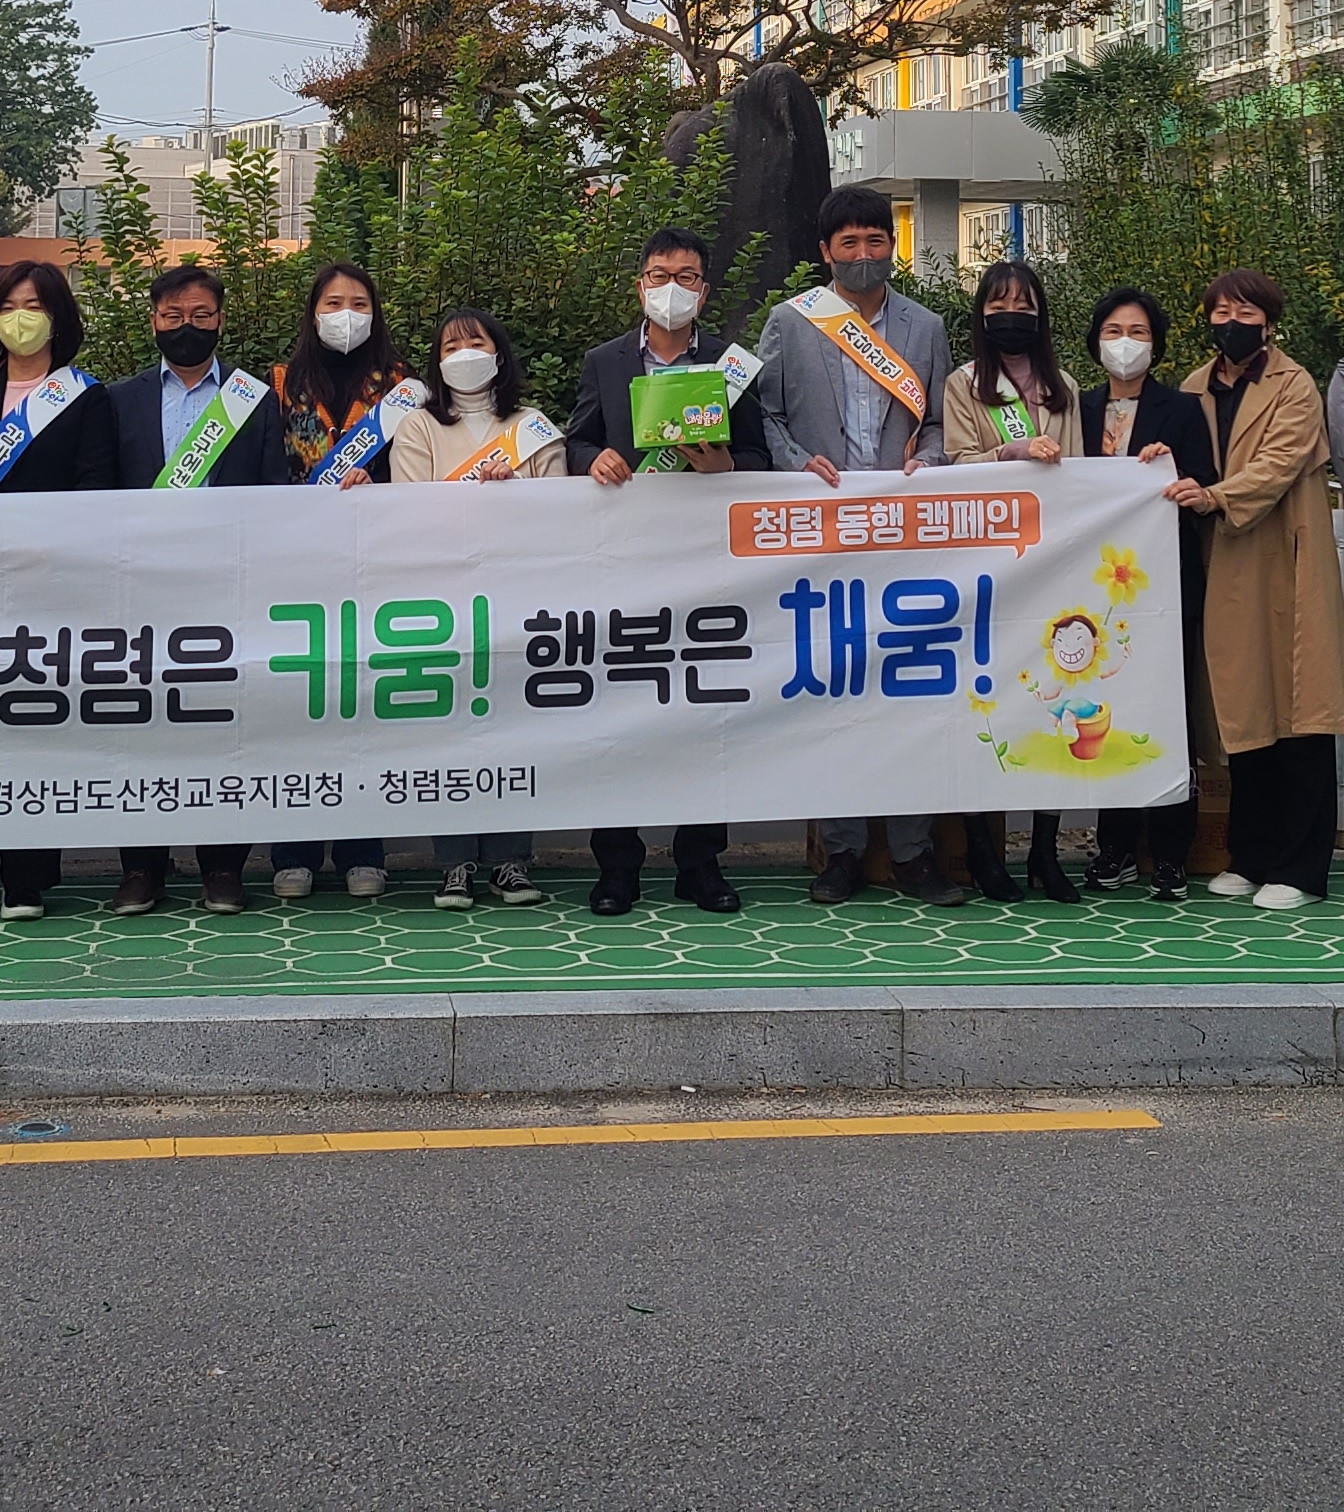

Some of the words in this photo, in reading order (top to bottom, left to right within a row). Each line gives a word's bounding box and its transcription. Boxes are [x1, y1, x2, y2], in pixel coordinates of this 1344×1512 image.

[839, 321, 902, 379] 저당잡힌
[170, 420, 224, 488] 친구에겐
[753, 506, 824, 549] 청렴
[835, 502, 904, 545] 동행
[916, 498, 1021, 543] 캠페인
[268, 594, 490, 721] 키움!
[523, 605, 752, 709] 행복은
[780, 574, 993, 698] 채움!
[378, 765, 537, 804] 청렴동아리
